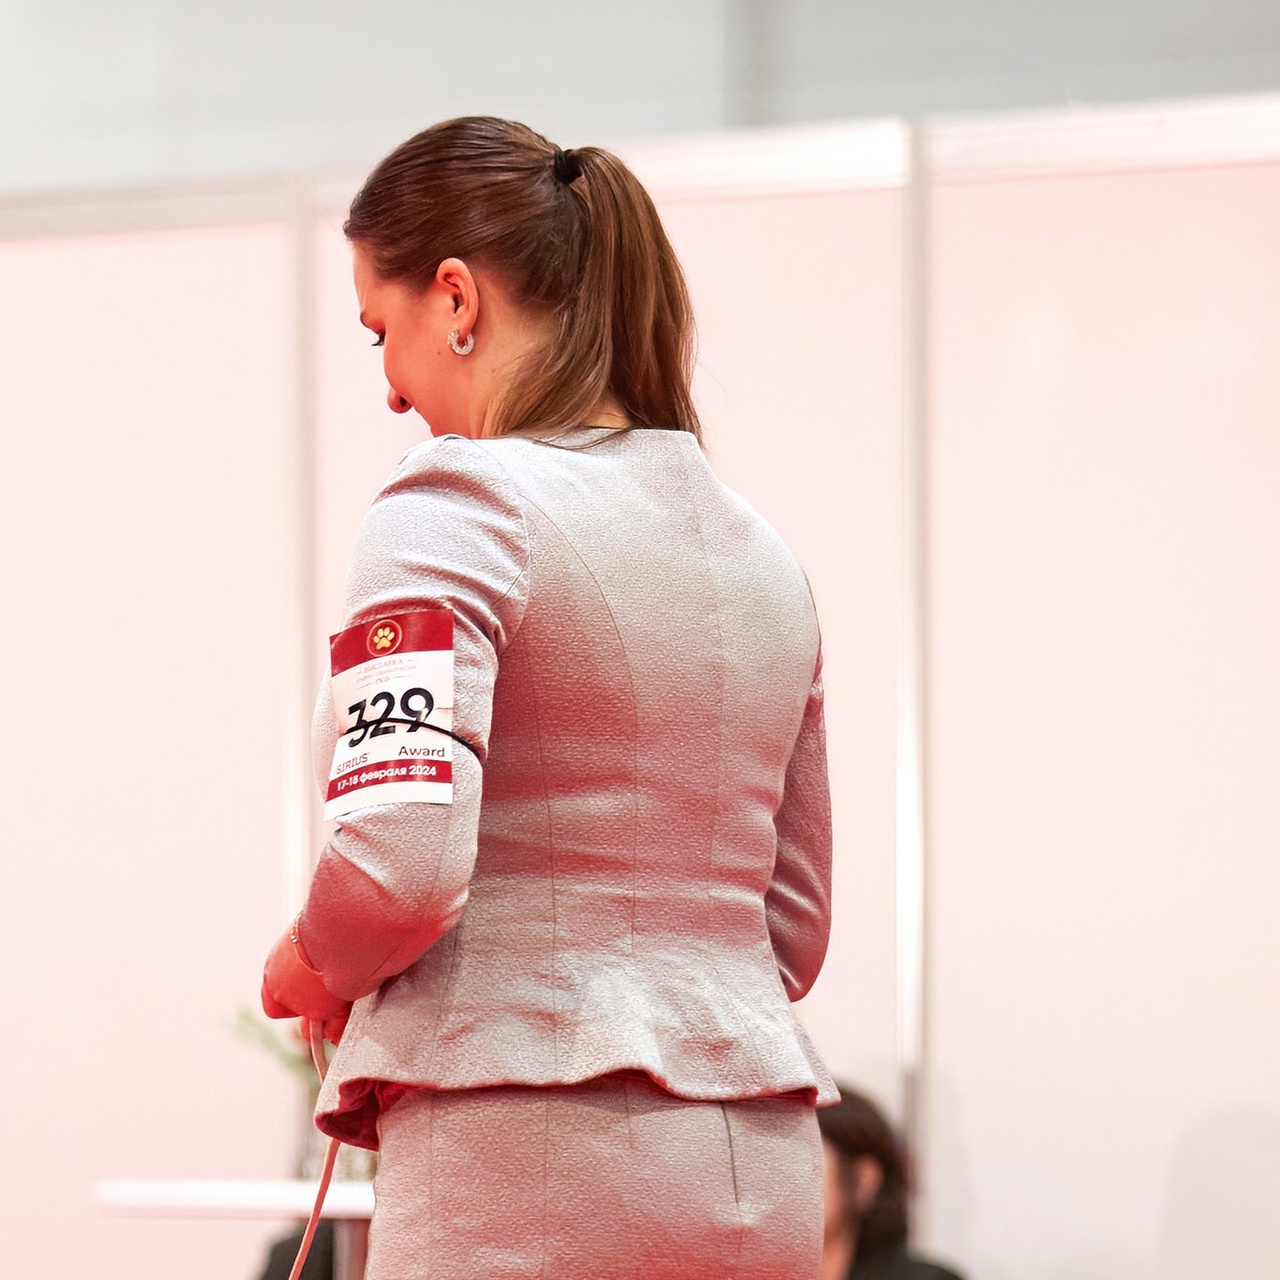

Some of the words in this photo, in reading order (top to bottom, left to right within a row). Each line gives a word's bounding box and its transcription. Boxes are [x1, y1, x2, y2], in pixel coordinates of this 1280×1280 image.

[347, 687, 435, 748] 329
[336, 753, 368, 774] SIRIUS
[398, 746, 445, 757] Award
[359, 767, 407, 784] февраля
[408, 765, 437, 776] 2024
